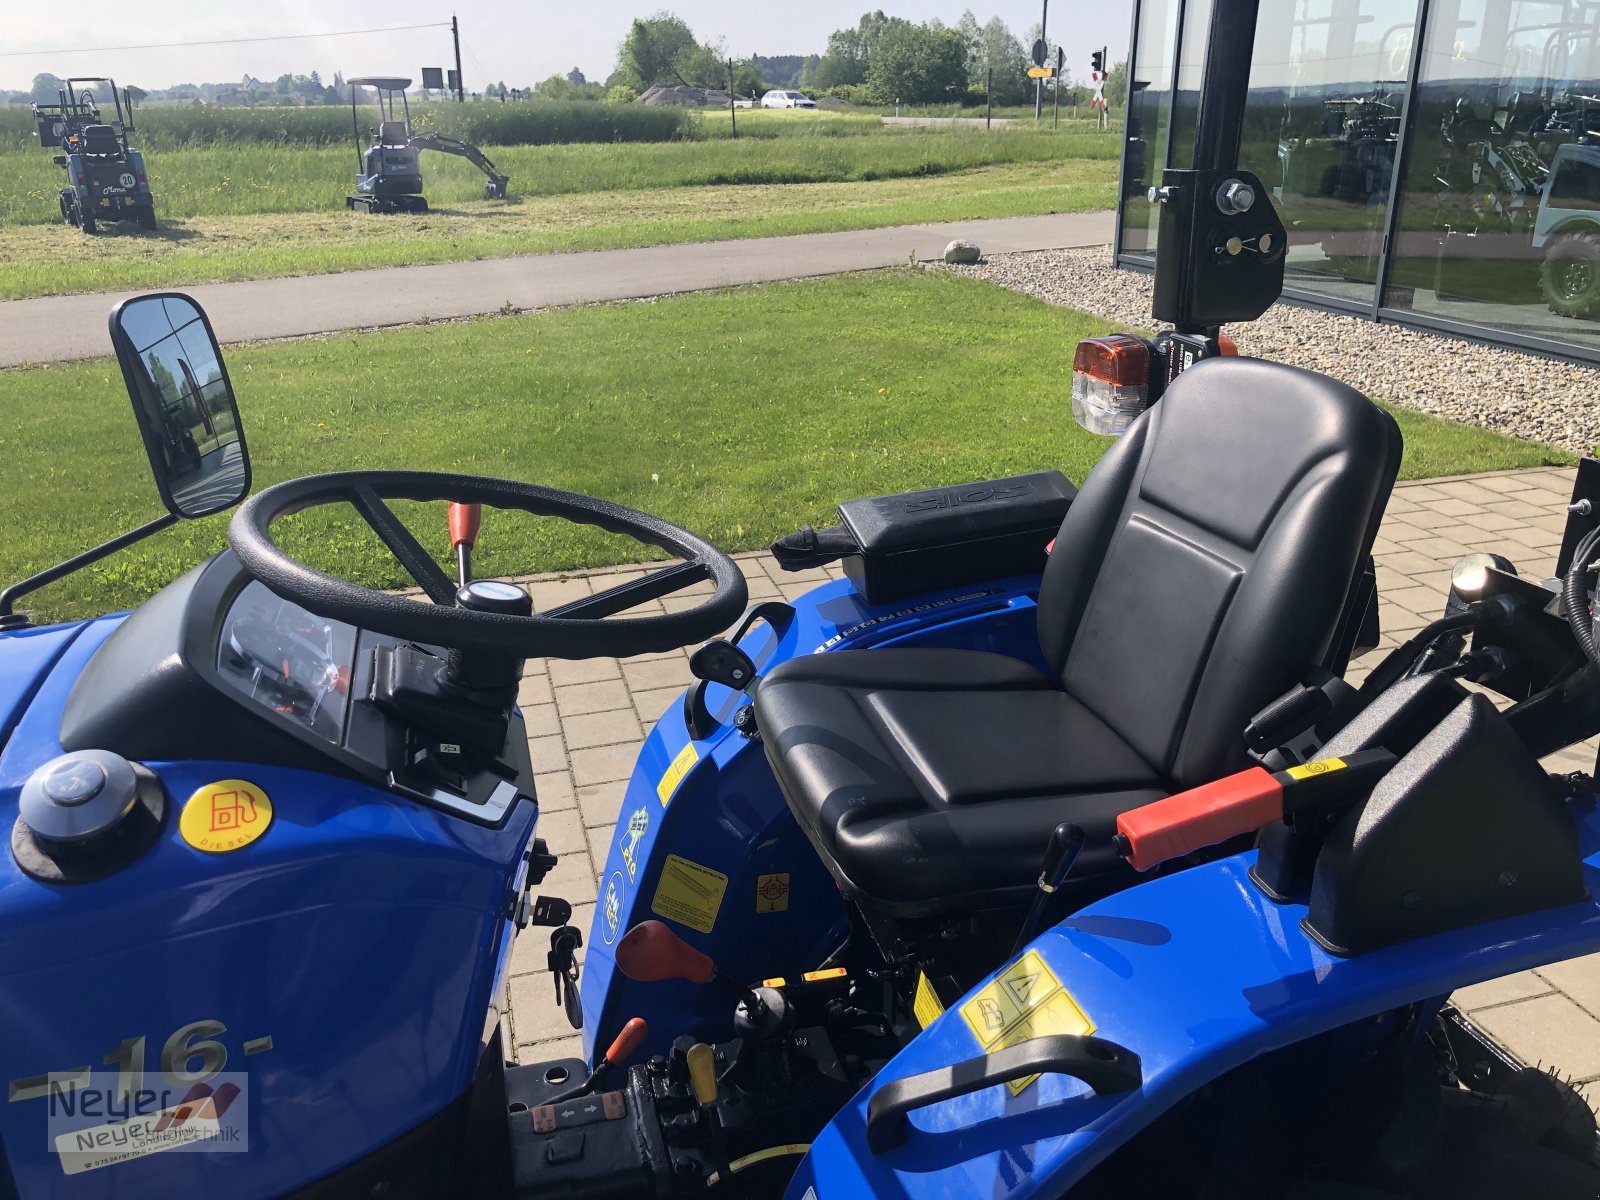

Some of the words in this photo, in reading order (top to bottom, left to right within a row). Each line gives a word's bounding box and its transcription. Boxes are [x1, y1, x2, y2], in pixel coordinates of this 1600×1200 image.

[122, 175, 133, 185] 20
[199, 833, 252, 849] DIESEL
[76, 1120, 151, 1152] Neyer
